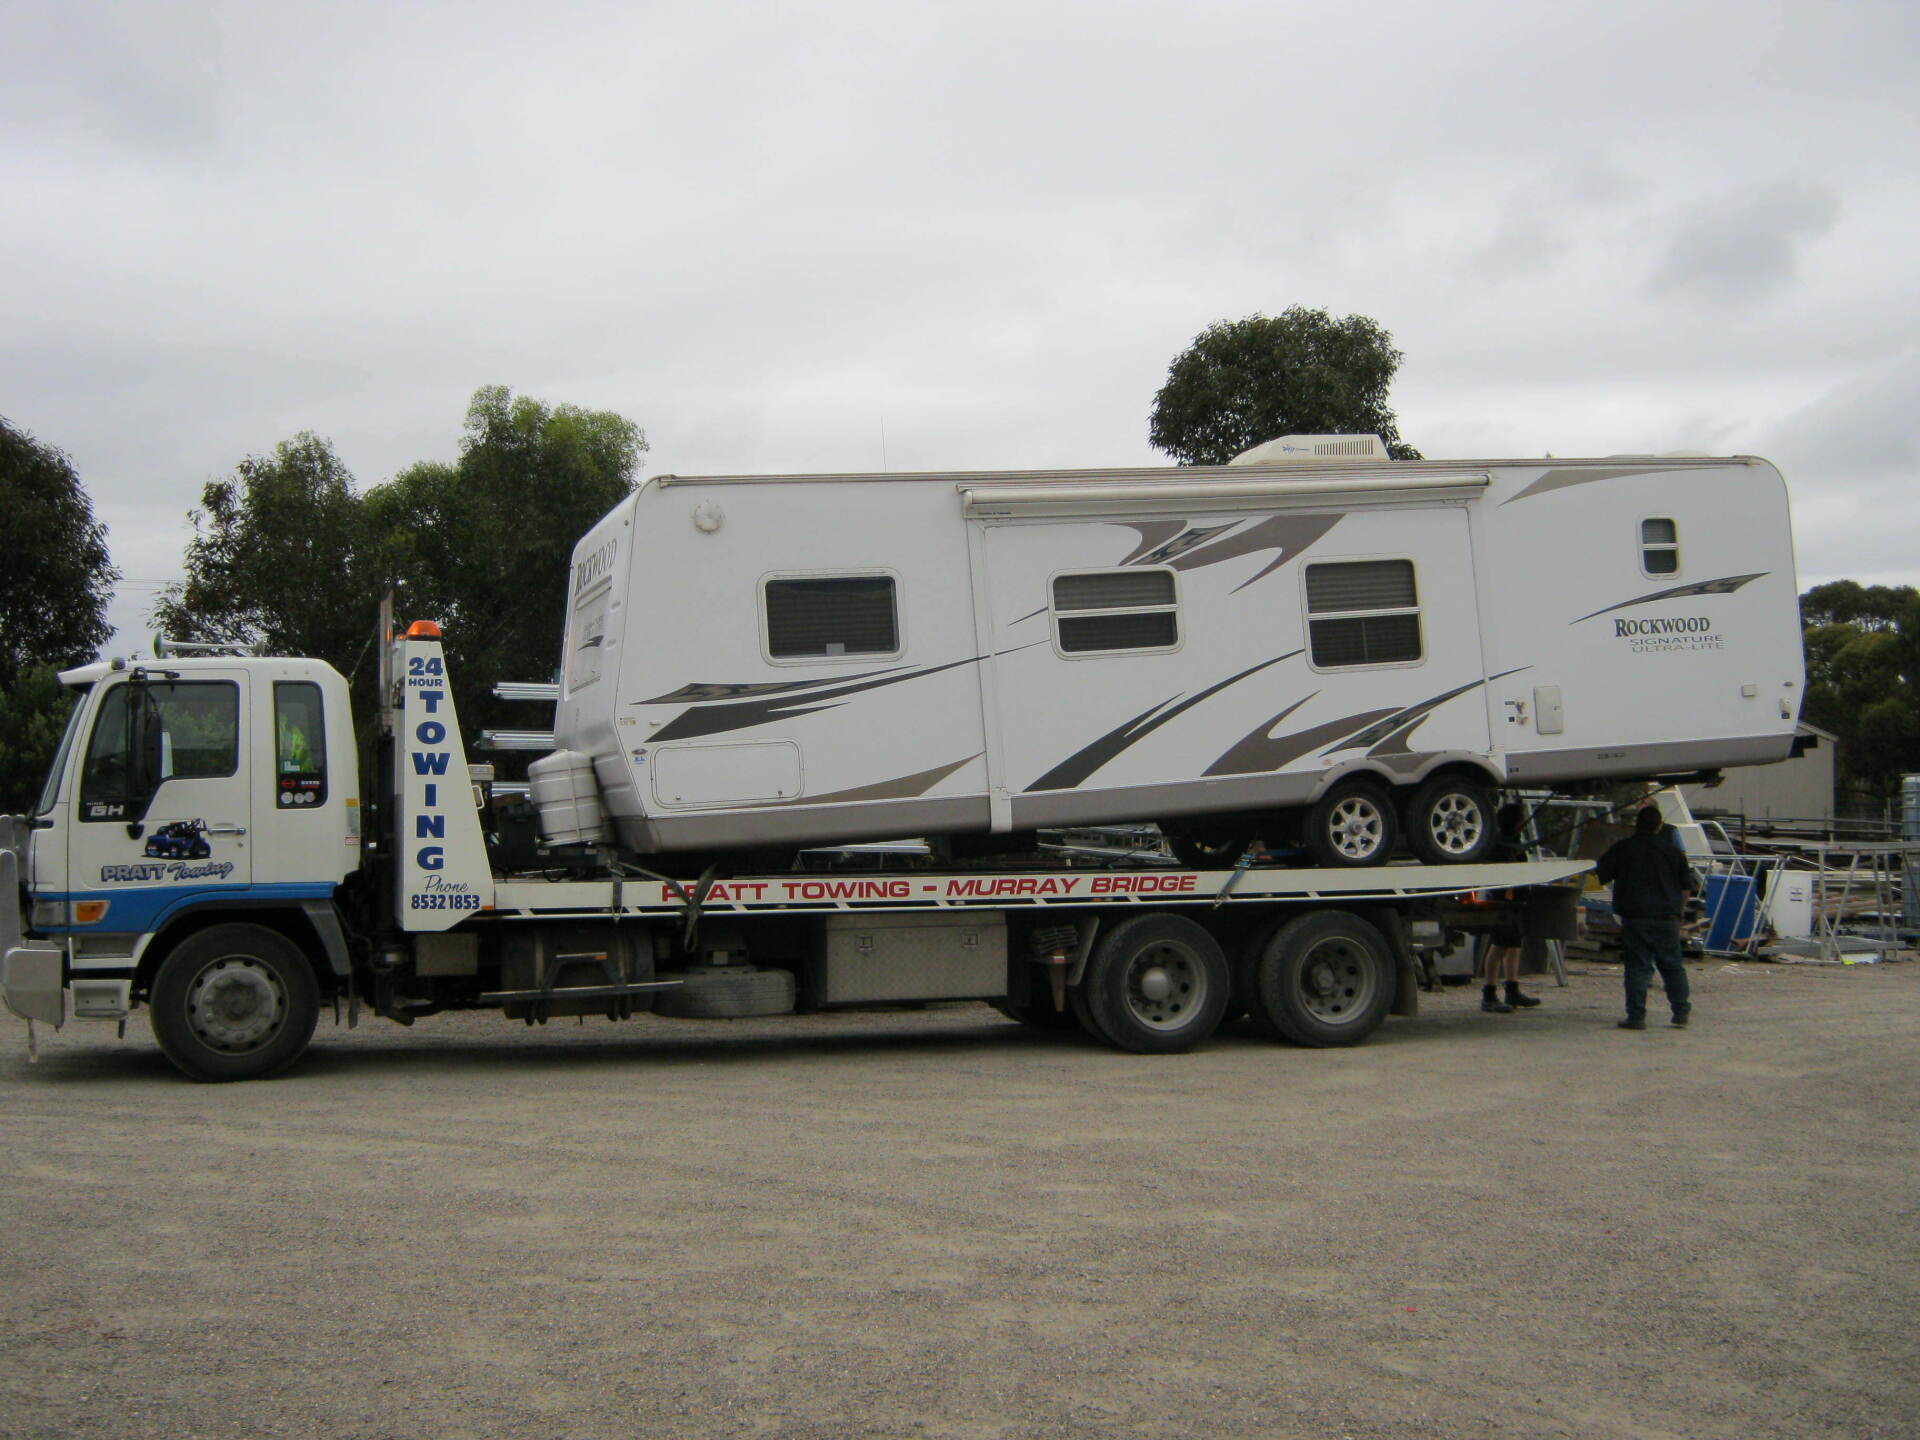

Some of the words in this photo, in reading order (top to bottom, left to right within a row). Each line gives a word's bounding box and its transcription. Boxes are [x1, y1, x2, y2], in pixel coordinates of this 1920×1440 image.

[1614, 617, 1711, 637] ROCKWOOD
[1630, 634, 1724, 646] SIGNATURE
[1631, 642, 1725, 653] ULTRA-LITE
[408, 656, 444, 676] 24
[408, 678, 444, 687] HOUR
[411, 690, 451, 871] TOWING
[90, 804, 125, 817] GH
[101, 863, 167, 882] PRATT
[167, 861, 234, 880] Towing
[424, 874, 470, 893] Phone
[782, 881, 910, 900] TOWING
[946, 878, 1081, 897] MURRAY
[1090, 875, 1197, 894] BRIDGE
